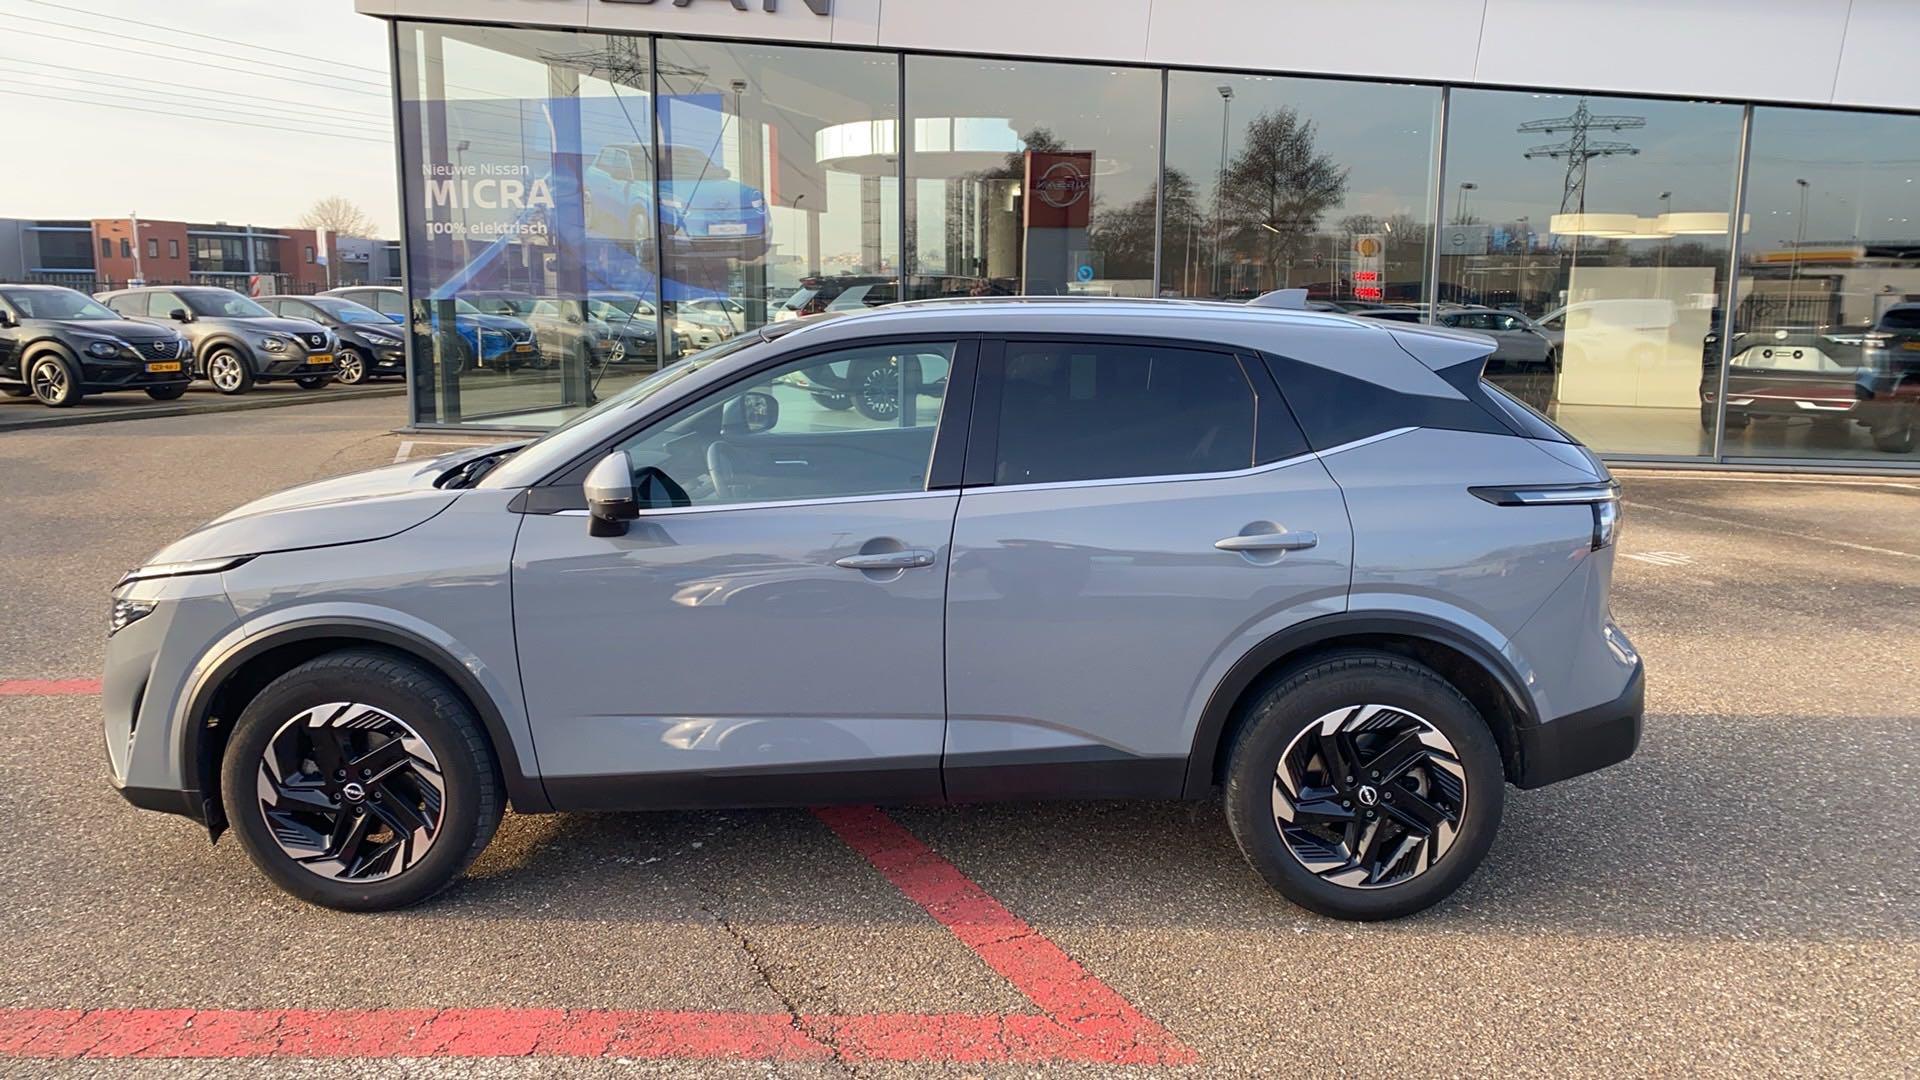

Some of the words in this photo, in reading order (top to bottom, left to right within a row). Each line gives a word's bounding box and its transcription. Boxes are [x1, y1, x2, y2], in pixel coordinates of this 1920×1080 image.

[423, 164, 476, 176] Nieuwe
[480, 163, 529, 176] Nissan
[424, 179, 555, 209] MICRA
[426, 222, 467, 234] 100%
[470, 221, 548, 234] elektrisch
